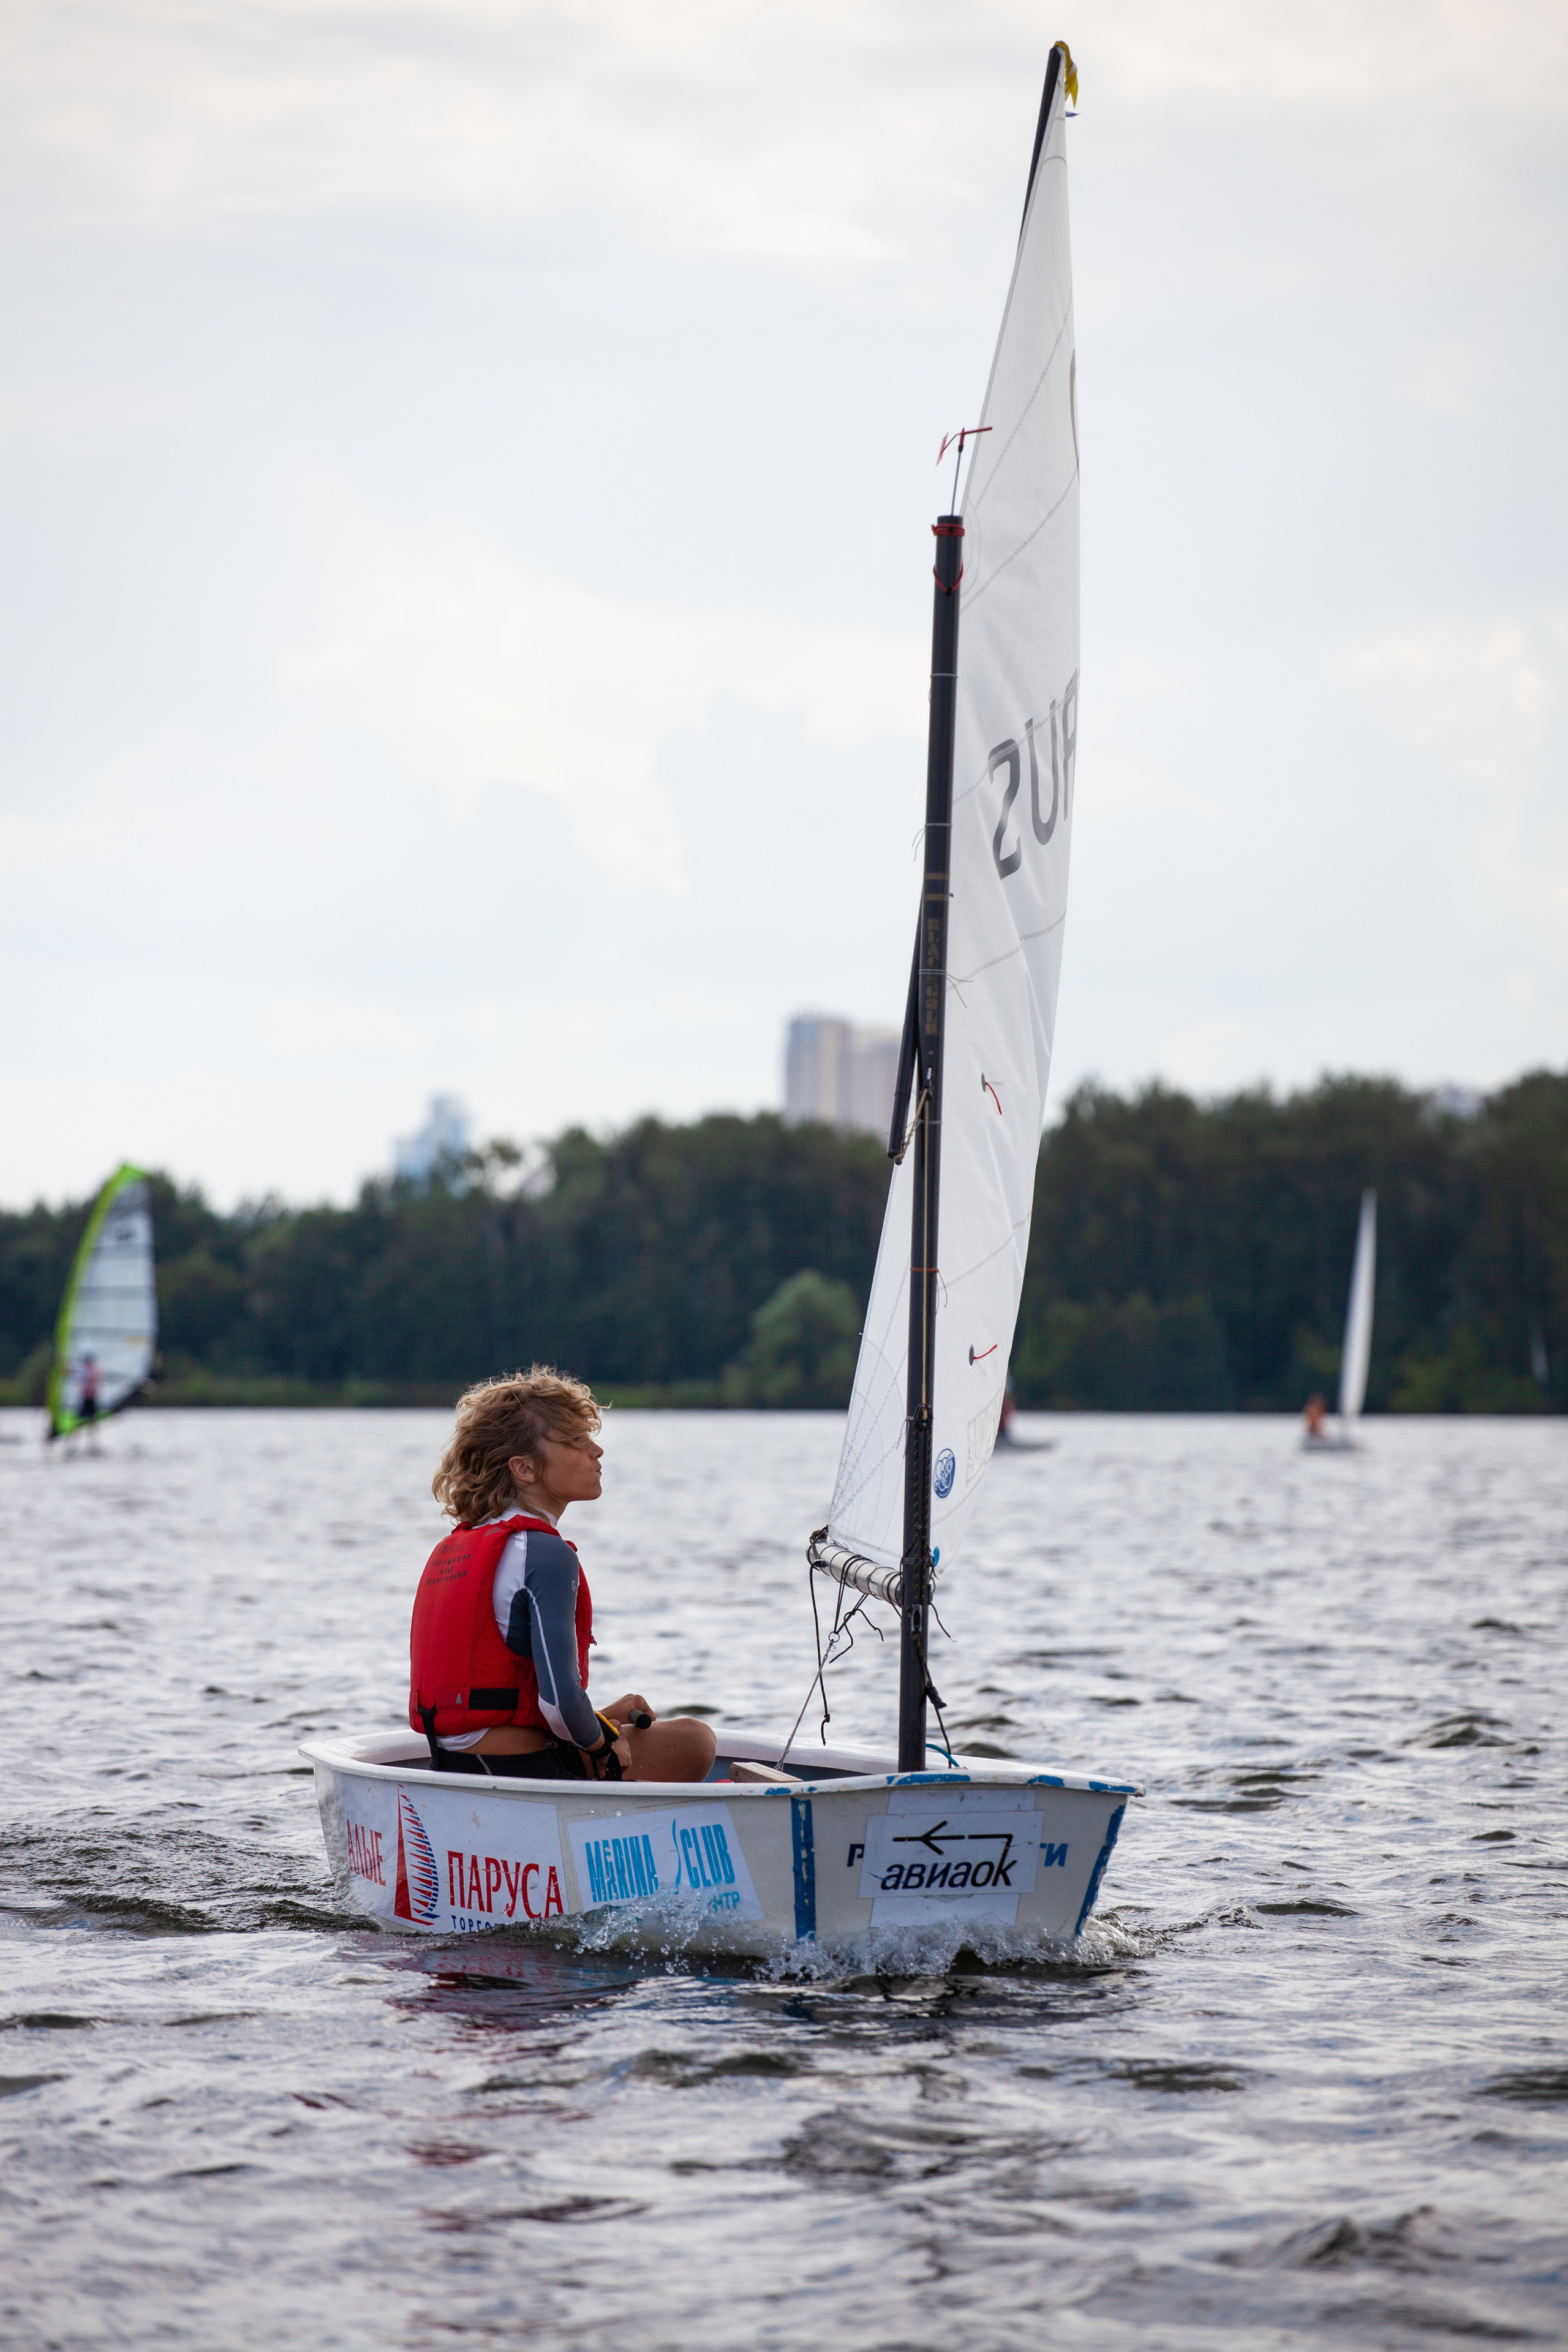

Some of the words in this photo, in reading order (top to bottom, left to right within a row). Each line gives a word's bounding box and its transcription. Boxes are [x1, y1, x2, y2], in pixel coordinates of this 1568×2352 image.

[346, 1819, 386, 1887] АЛЫЕ
[447, 1850, 564, 1919] ПАРУСА
[586, 1834, 658, 1903] MARINA
[680, 1823, 735, 1889] CLUB
